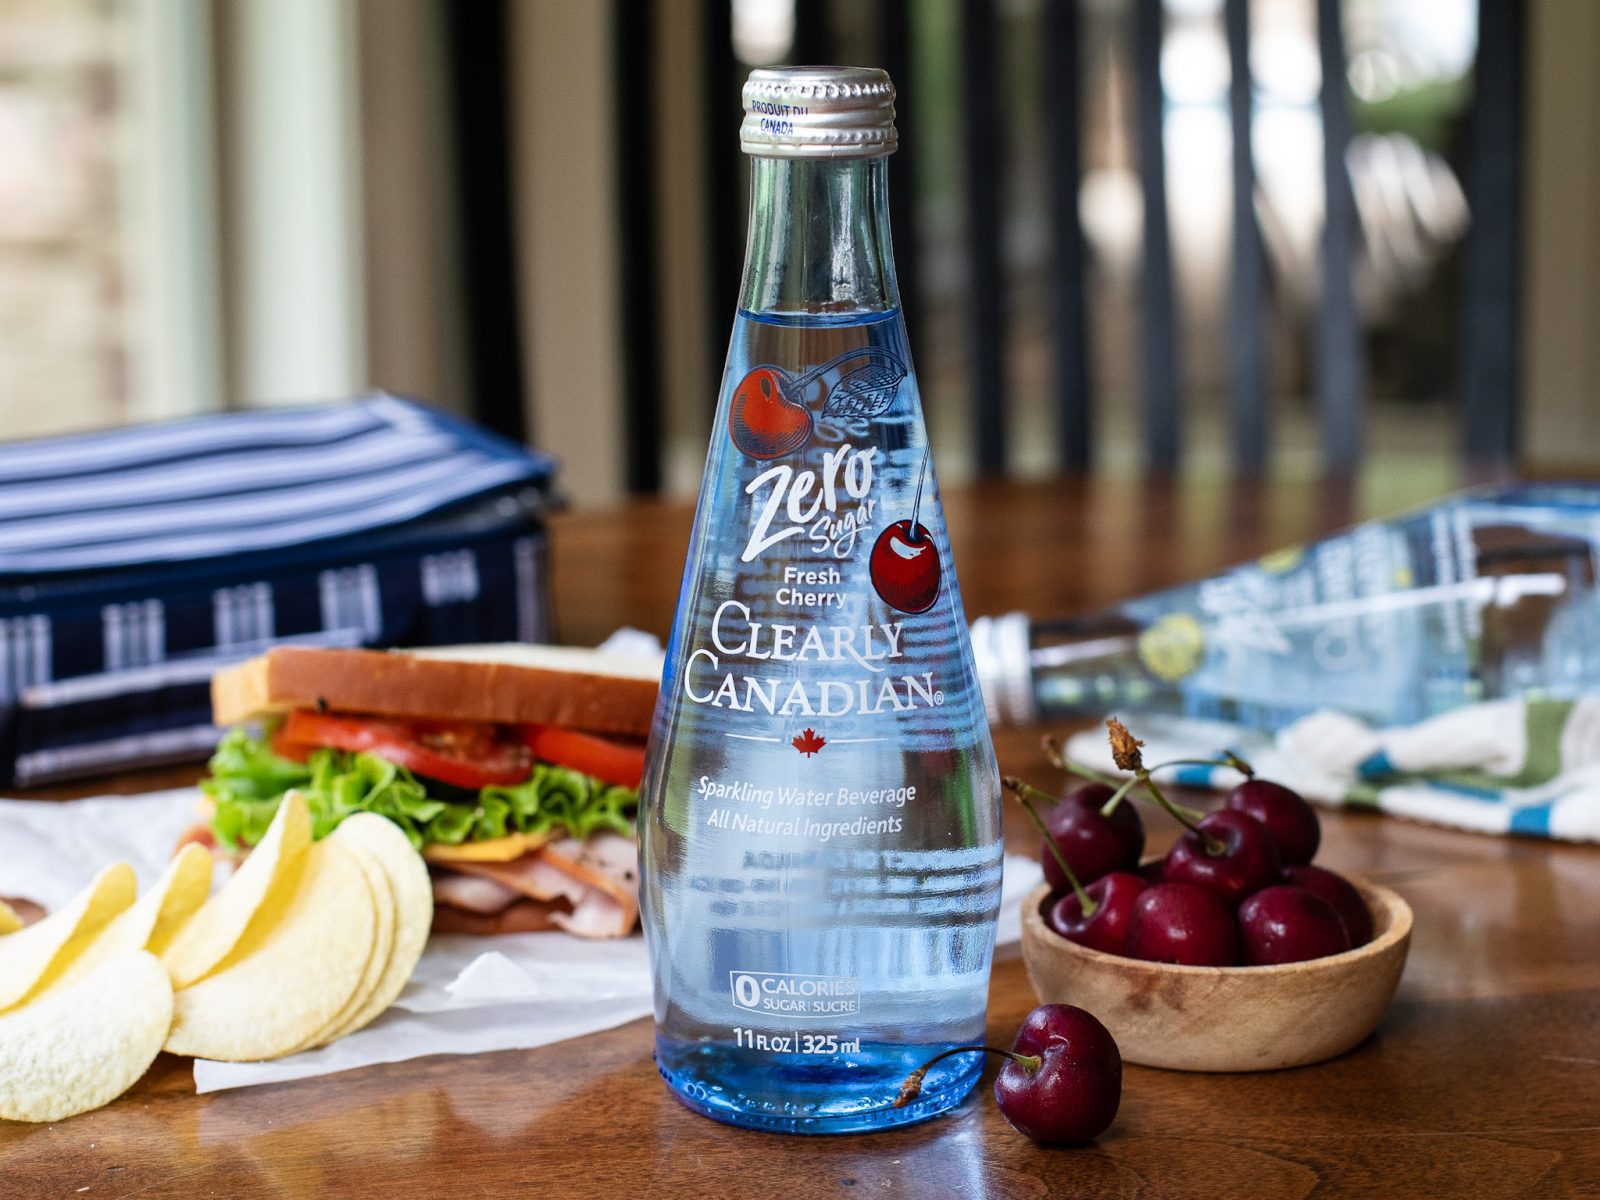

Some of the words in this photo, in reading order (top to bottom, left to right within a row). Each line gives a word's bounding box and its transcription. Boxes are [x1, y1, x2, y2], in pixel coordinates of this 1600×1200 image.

[752, 99, 790, 117] PRODUIT
[760, 118, 794, 135] CANADA
[741, 443, 877, 563] Zero
[809, 498, 876, 559] Sugar
[784, 567, 841, 585] Fresh
[775, 588, 847, 610] Cherry
[711, 600, 904, 673] CLEARLY
[698, 776, 773, 809] Sparkling
[777, 786, 834, 806] Water
[836, 786, 916, 807] Beverage
[707, 809, 730, 829] All
[732, 812, 799, 836] Natural
[803, 815, 903, 842] Ingredients
[735, 975, 760, 1007] 0
[761, 978, 855, 996] CALORIES
[763, 997, 807, 1012] SUGAR
[813, 1000, 856, 1013] SUCRE
[733, 1027, 753, 1049] 11
[802, 1034, 838, 1055] 325
[840, 1037, 861, 1054] ml
